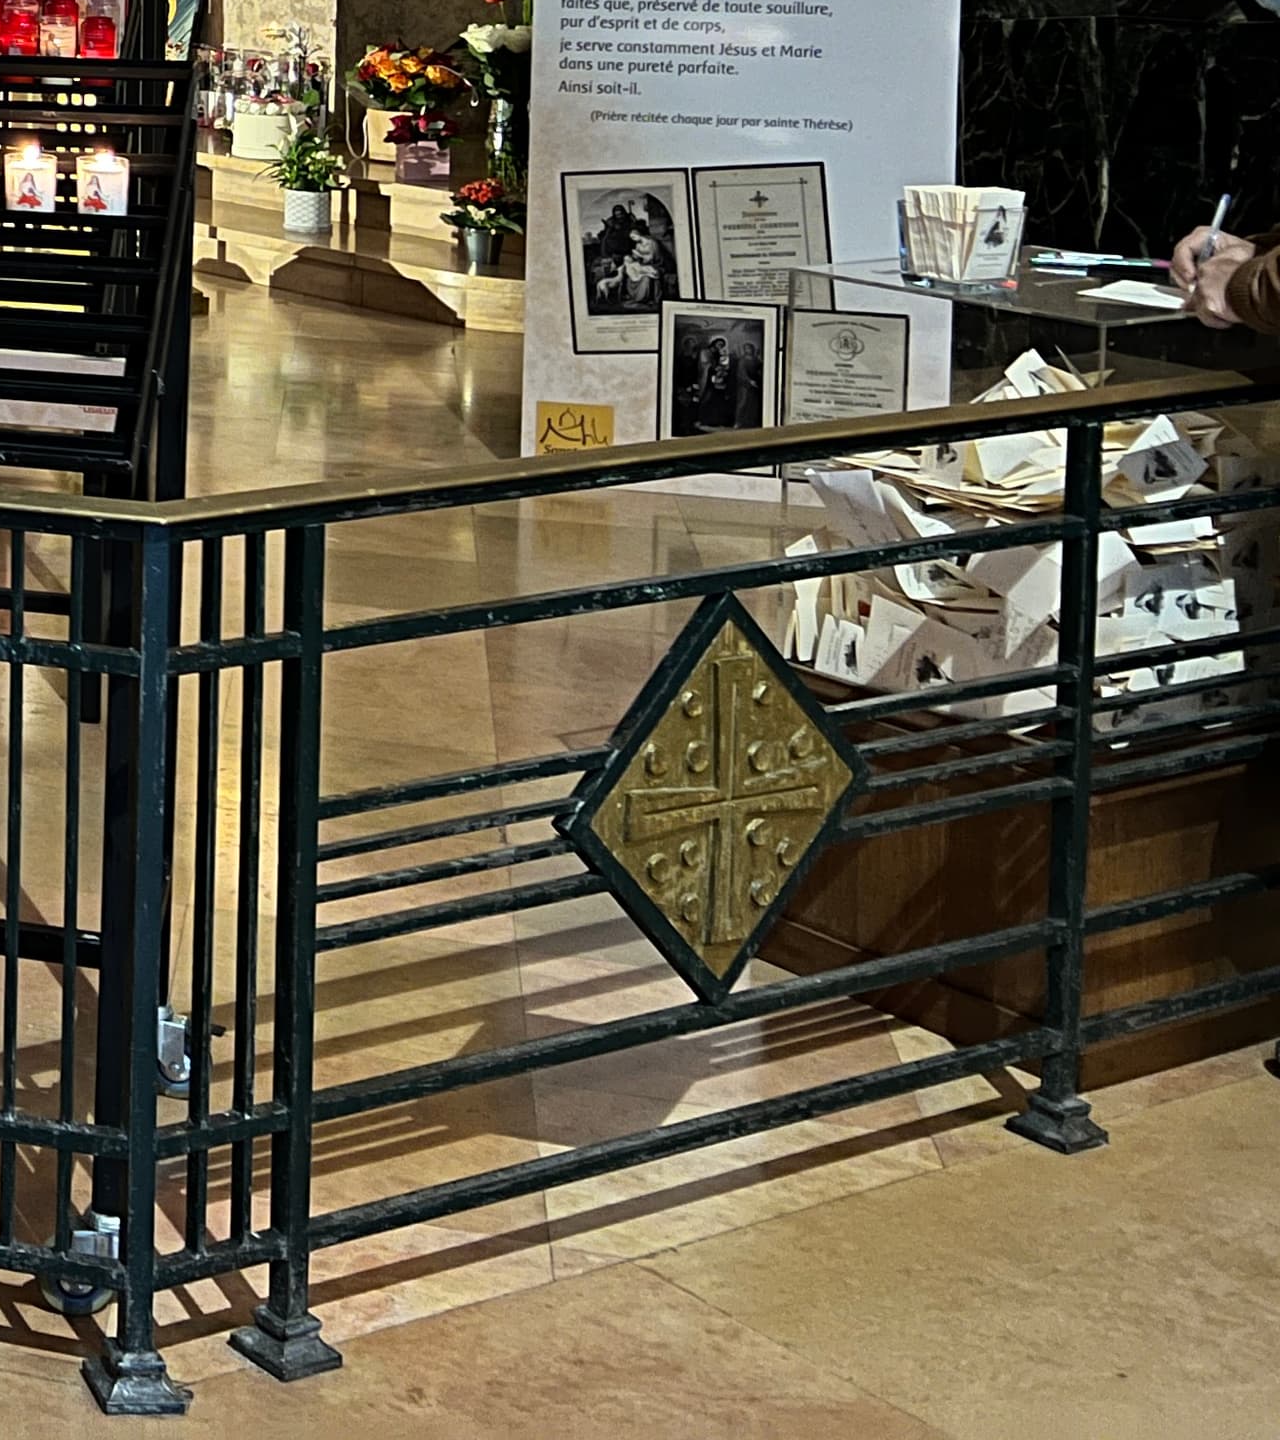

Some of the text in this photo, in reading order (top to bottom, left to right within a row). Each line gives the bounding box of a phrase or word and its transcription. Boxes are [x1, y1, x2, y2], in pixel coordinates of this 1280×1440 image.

[604, 0, 634, 12] que,
[702, 0, 720, 12] de
[725, 1, 762, 13] toute
[766, 1, 832, 17] souillure,
[560, 18, 584, 30] pur
[644, 19, 657, 29] et
[662, 18, 679, 30] de
[684, 21, 725, 34] corps,
[560, 38, 822, 58] je serve constamment Jésus et Marie
[559, 57, 738, 76] dans une pureté parfaite.
[558, 80, 641, 95] Ainsi soit-il.
[590, 110, 853, 132] (Prière récitée chaque jour par sainte Thérèse)
